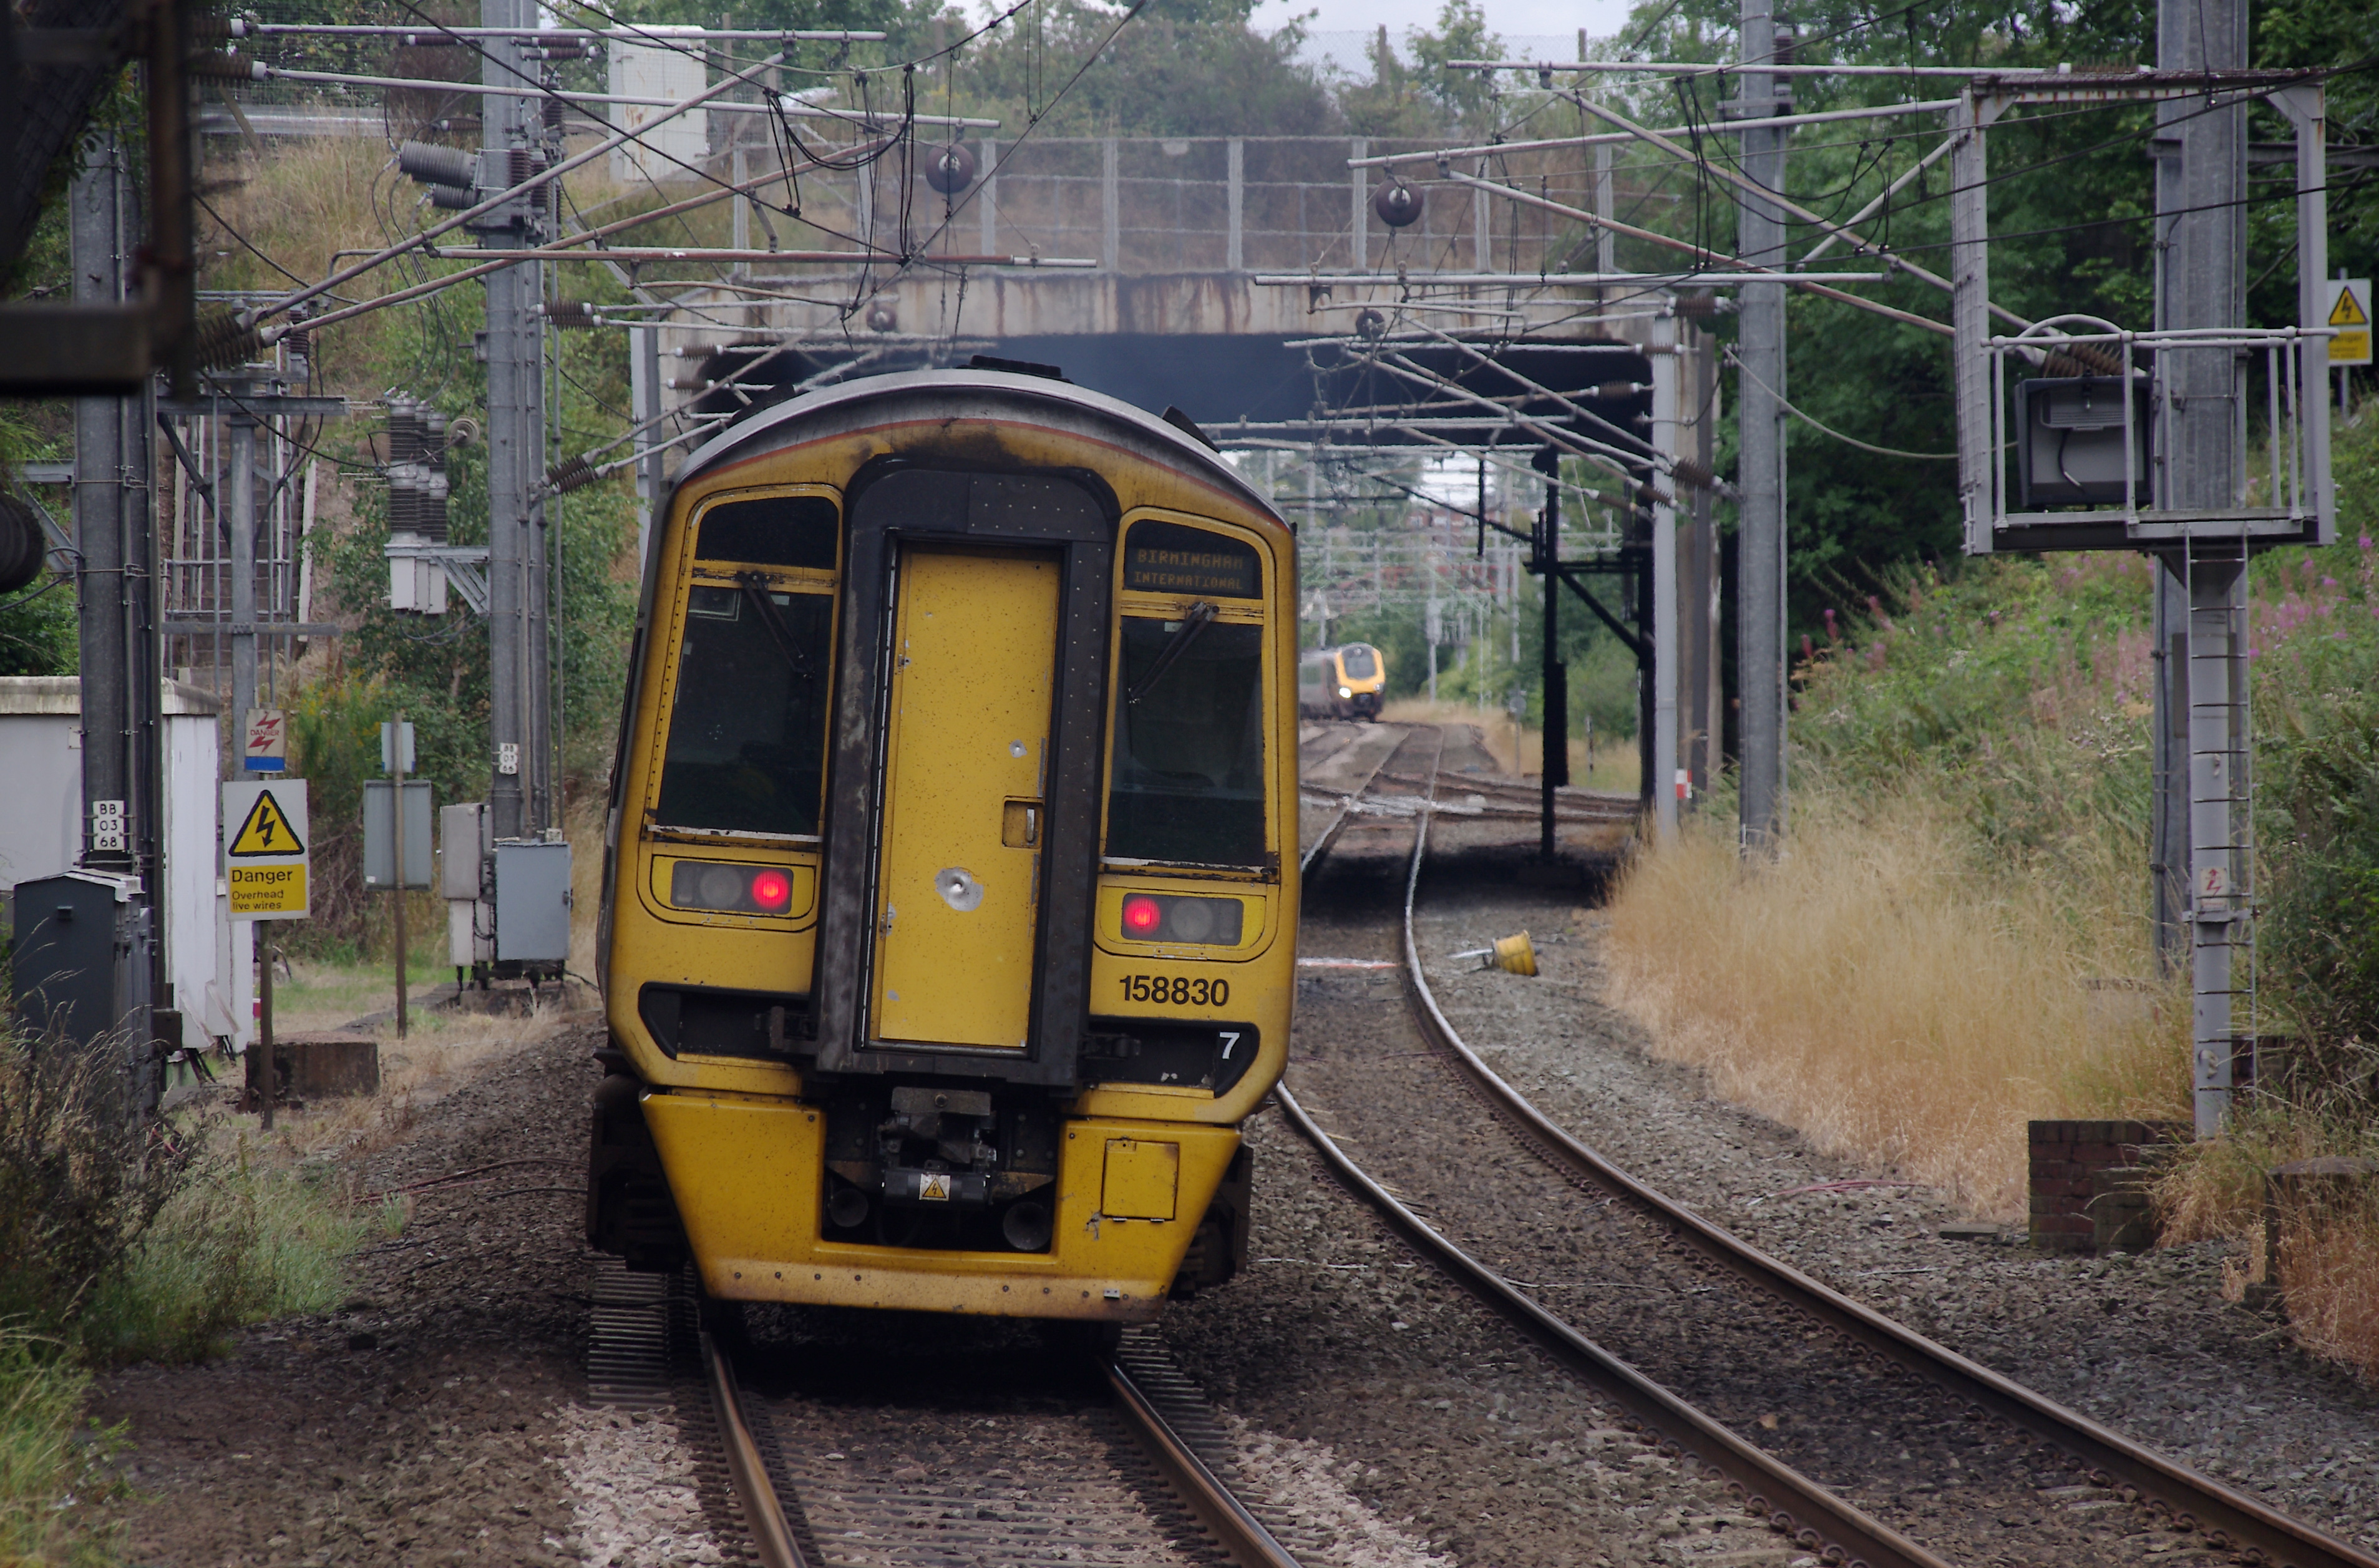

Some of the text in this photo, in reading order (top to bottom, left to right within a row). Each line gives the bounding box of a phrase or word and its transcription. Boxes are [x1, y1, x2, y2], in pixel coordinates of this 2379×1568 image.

[1137, 548, 1243, 570] BIRMINGHAM
[1134, 571, 1243, 590] INTERNATIONAL
[100, 804, 116, 814] BB
[100, 820, 117, 831] 03
[100, 837, 117, 847] 68
[231, 870, 293, 885] Danger
[232, 890, 284, 900] Overhead
[233, 901, 281, 910] live wires
[1119, 975, 1229, 1006] 158830
[1219, 1031, 1240, 1059] 7
